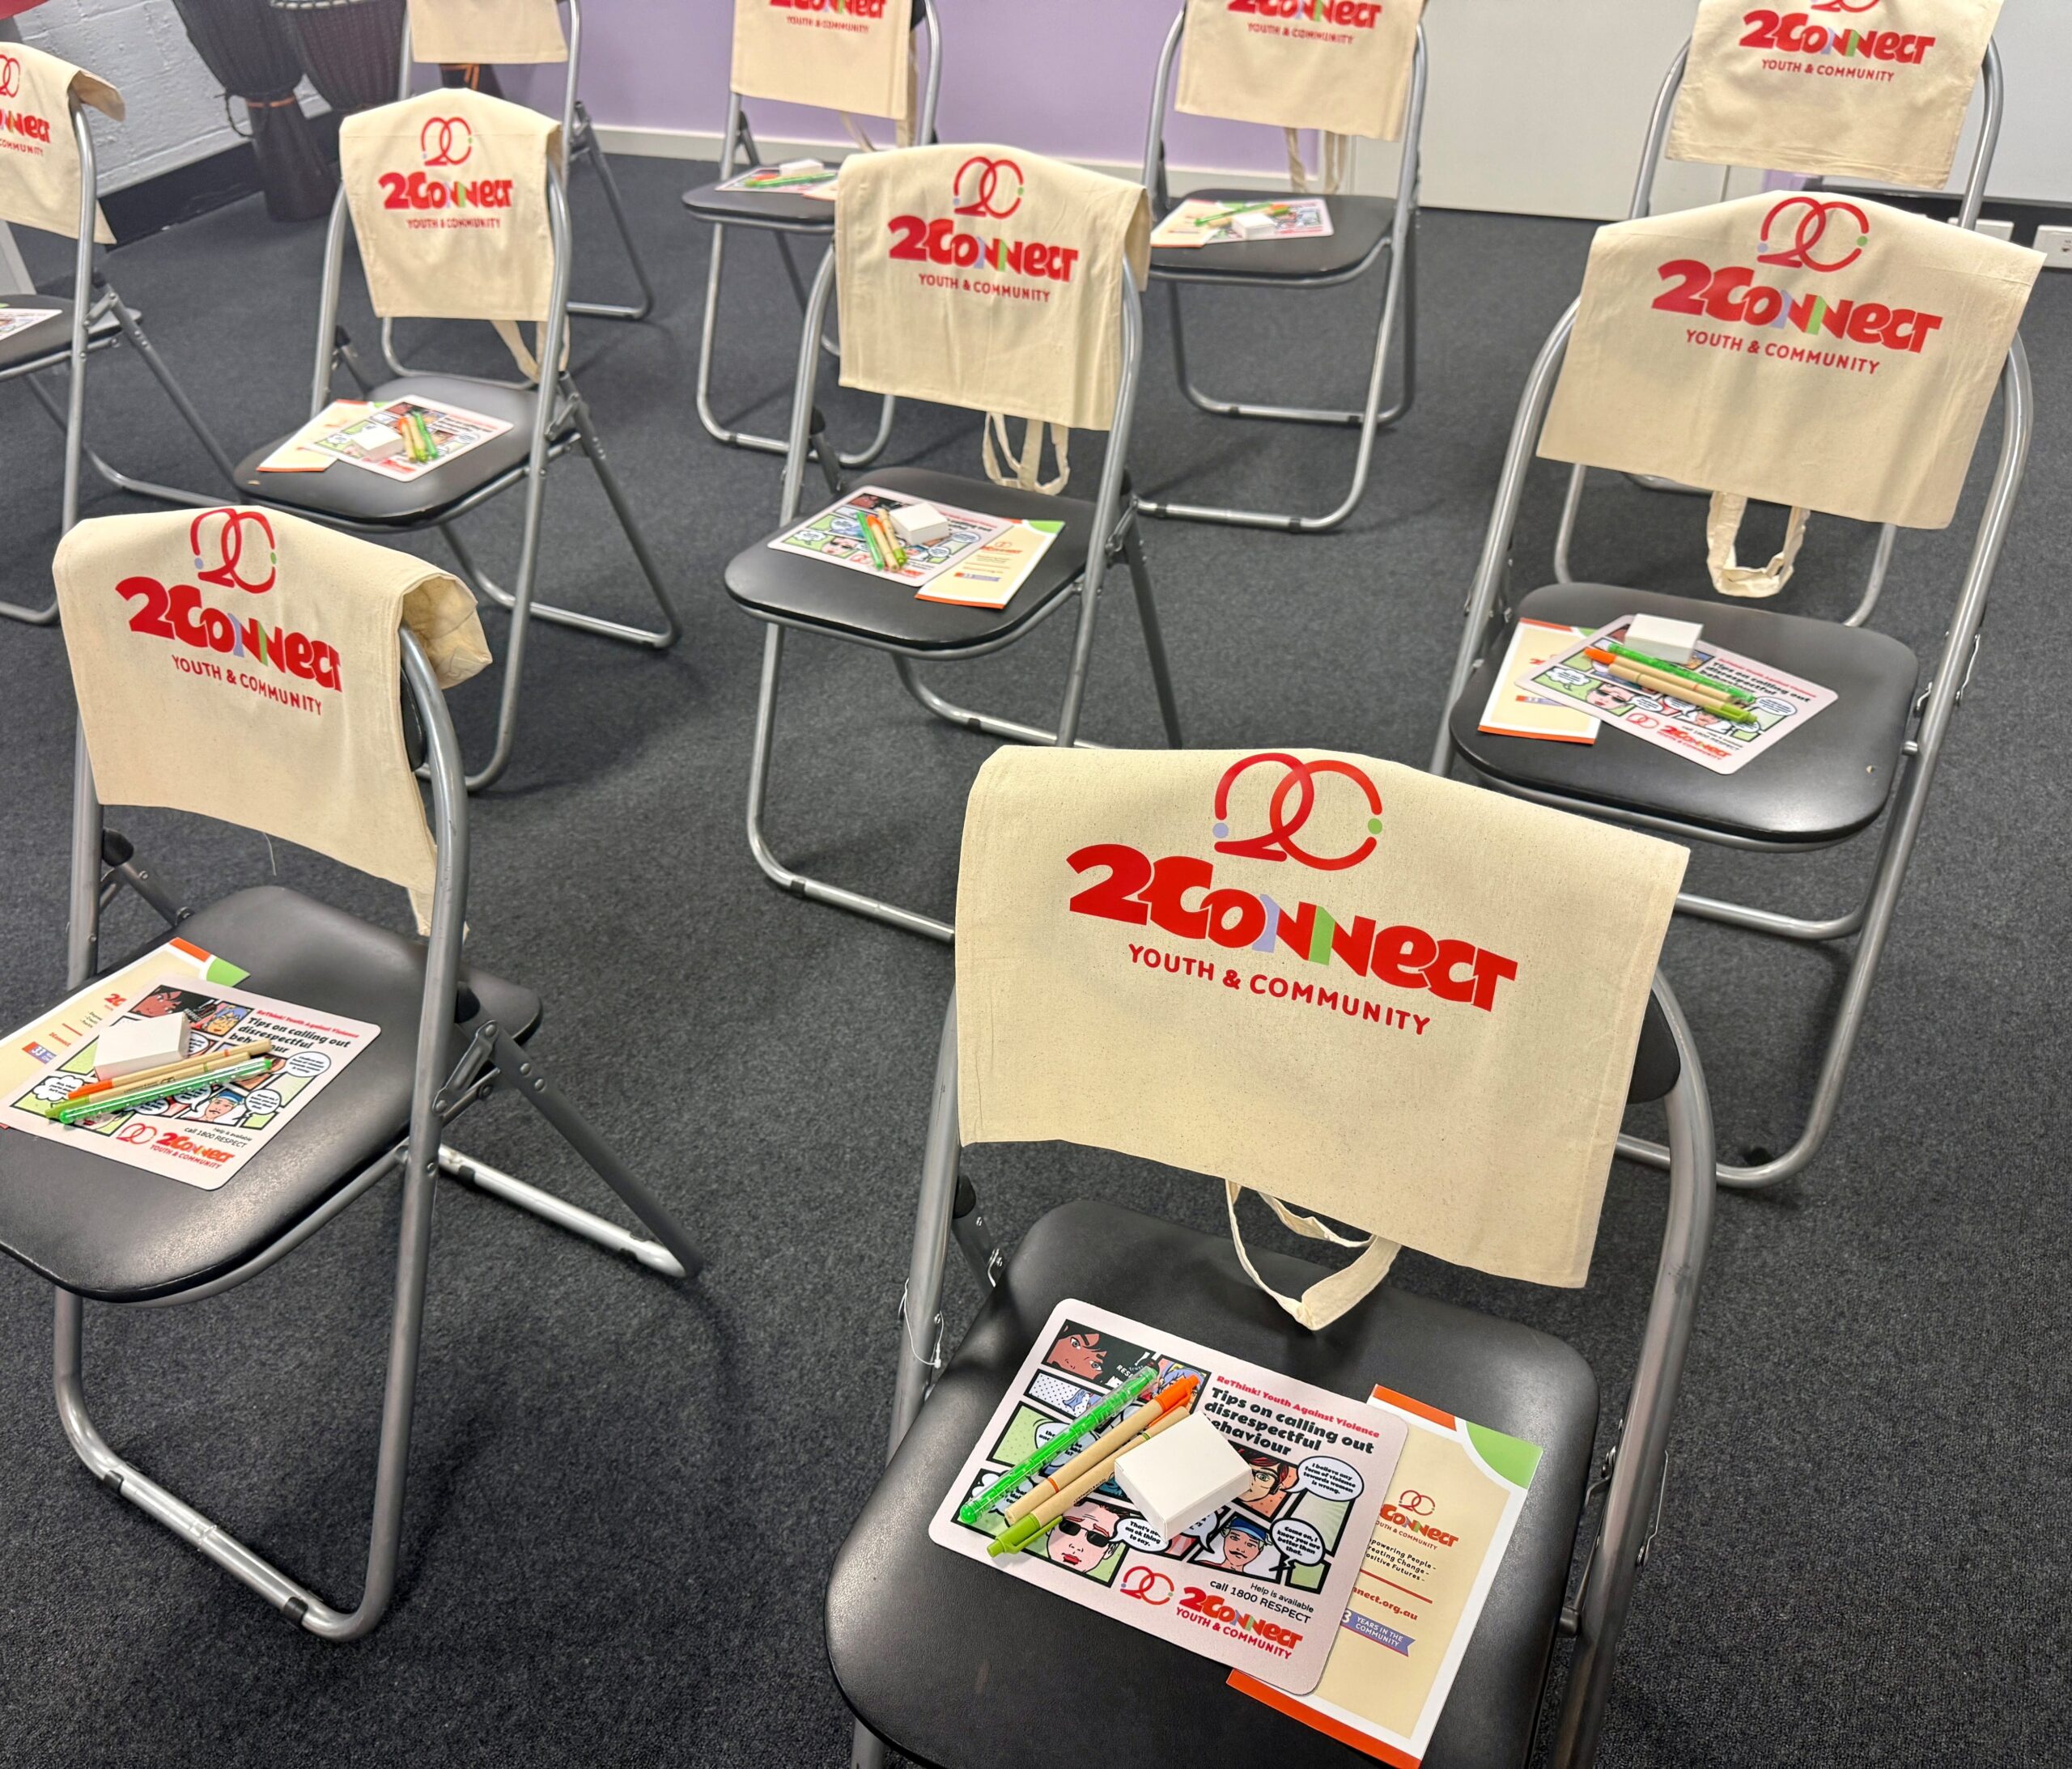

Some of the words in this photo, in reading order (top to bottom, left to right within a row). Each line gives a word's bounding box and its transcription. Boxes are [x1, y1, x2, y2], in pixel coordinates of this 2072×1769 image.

[1247, 22, 1280, 35] YOUTH
[1282, 27, 1290, 36] &
[1292, 28, 1354, 45] COMMUNITY
[1762, 59, 1802, 73] YOUTH
[1805, 64, 1813, 74] &
[1816, 65, 1895, 82] COMMUNITY
[406, 218, 438, 228] YOUTH
[446, 218, 501, 229] COMMUNITY
[919, 273, 958, 289] YOUTH
[962, 280, 970, 291] &
[973, 282, 1051, 303] COMMUNITY
[1686, 329, 1743, 352] YOUTH
[1747, 341, 1760, 354] &
[1765, 343, 1880, 375] COMMUNITY
[172, 654, 223, 681] YOUTH
[227, 669, 237, 685] &
[240, 672, 322, 715] COMMUNITY
[1129, 944, 1213, 982] YOUTH
[1222, 969, 1241, 989] &
[1250, 974, 1431, 1036] COMMUNITY
[228, 1033, 290, 1054] behour
[238, 1026, 314, 1049] disrespectful
[248, 1017, 272, 1029] Tips
[272, 1024, 287, 1033] on
[288, 1027, 329, 1043] calling
[329, 1038, 351, 1048] out
[197, 1130, 215, 1139] 1800
[215, 1135, 248, 1148] RESPECT
[150, 1144, 173, 1155] YOUTH
[179, 1152, 223, 1169] COMMUNITY
[1216, 1376, 1261, 1396] ReThink!
[1263, 1391, 1291, 1407] Youth
[1293, 1403, 1334, 1423] Against
[1336, 1417, 1380, 1438] Violence
[1204, 1401, 1322, 1452] disrespectful
[1212, 1387, 1247, 1409] Tips
[1250, 1403, 1273, 1419] on
[1276, 1414, 1338, 1444] calling
[1341, 1436, 1375, 1454] out
[1211, 1419, 1292, 1456] ehaviour
[1303, 1471, 1329, 1484] towards
[1330, 1480, 1353, 1493] women
[1305, 1466, 1321, 1476] form
[1329, 1473, 1357, 1488] violence
[1315, 1463, 1339, 1476] believe
[1339, 1472, 1352, 1481] any
[1318, 1482, 1340, 1495] wrong.
[1130, 1521, 1150, 1533] That's
[1143, 1533, 1161, 1544] thing
[1284, 1526, 1302, 1536] Come
[1303, 1534, 1314, 1542] on,
[1376, 1520, 1391, 1531] OUTH
[1399, 1530, 1437, 1551] COMMUNITY
[1137, 1537, 1150, 1546] say.
[1277, 1529, 1295, 1541] know
[1295, 1537, 1309, 1546] you
[1309, 1542, 1320, 1550] are
[1278, 1536, 1299, 1547] better
[1299, 1543, 1315, 1555] than
[1286, 1546, 1302, 1556] that.
[1369, 1538, 1406, 1558] powering
[1365, 1552, 1391, 1567] ositive
[1368, 1546, 1395, 1562] reating
[1210, 1580, 1228, 1592] call
[1231, 1587, 1258, 1603] 1800
[1260, 1597, 1311, 1623] RESPECT
[1250, 1583, 1269, 1597] Help
[1270, 1590, 1277, 1598] is
[1279, 1593, 1314, 1613] available
[1352, 1586, 1418, 1620] nnect.org.au
[1176, 1606, 1211, 1627] YOUTH
[1212, 1623, 1220, 1631] &
[1222, 1626, 1292, 1660] COMMUNITY
[1356, 1623, 1399, 1647] COMMUNITY
[1357, 1616, 1379, 1631] YEARS
[1389, 1631, 1403, 1642] THE
